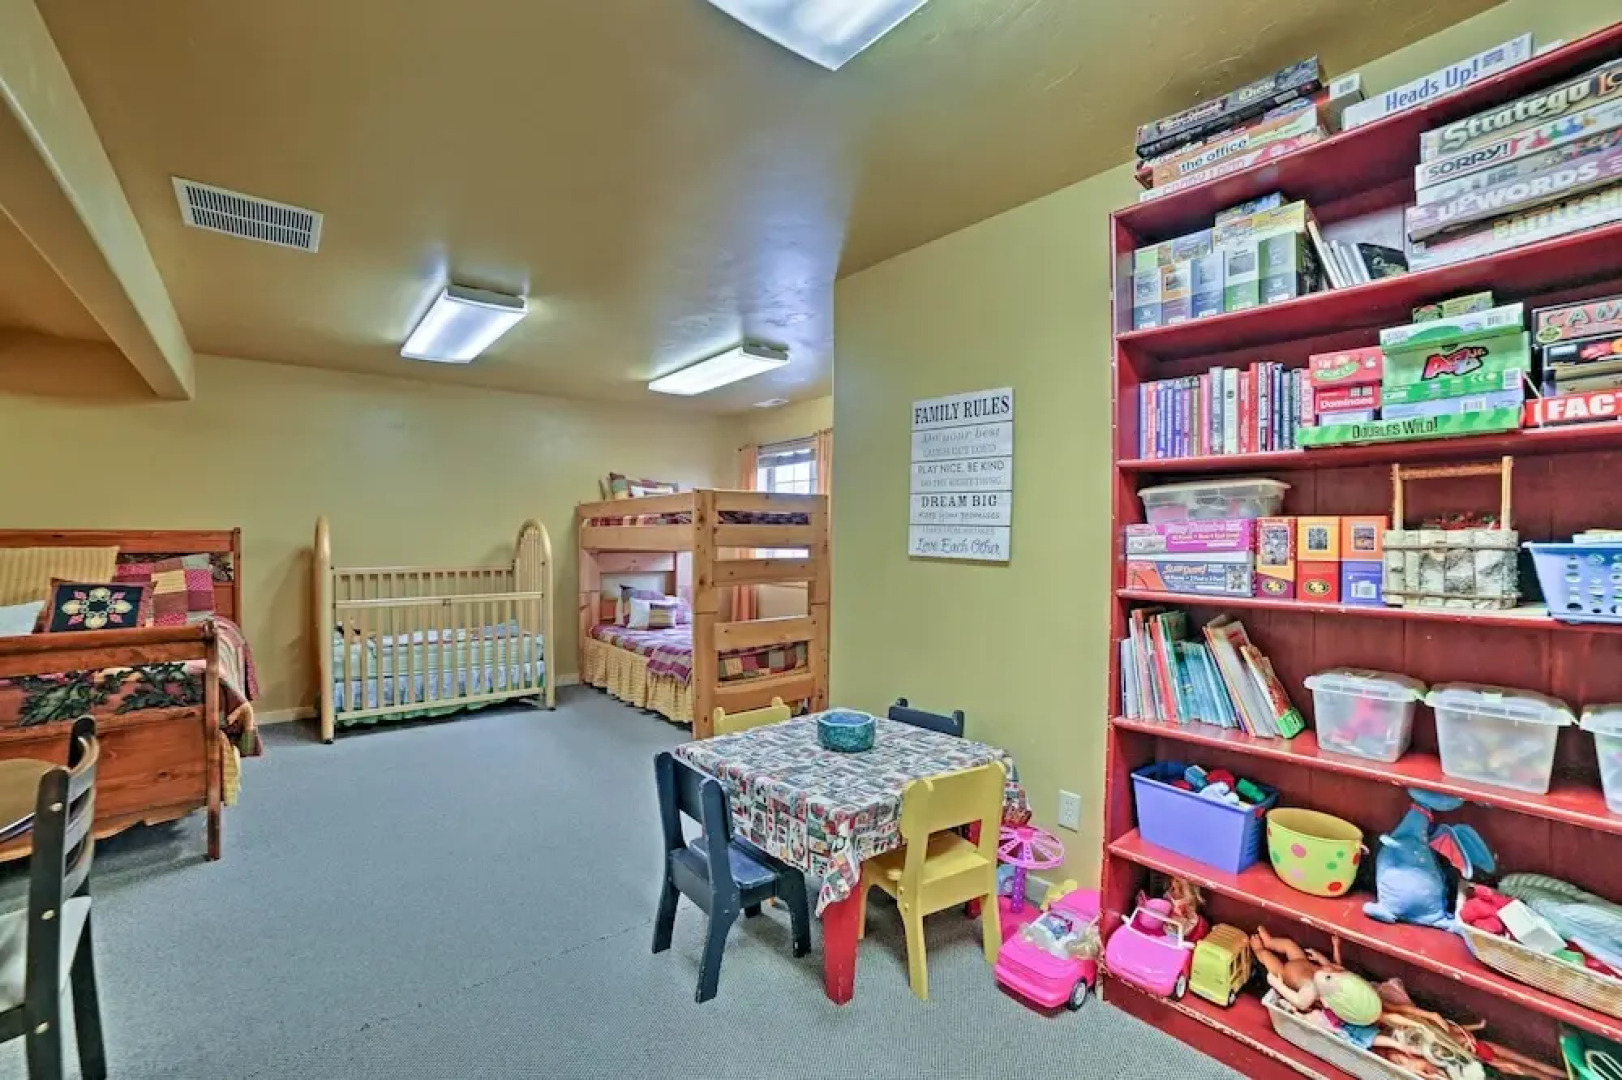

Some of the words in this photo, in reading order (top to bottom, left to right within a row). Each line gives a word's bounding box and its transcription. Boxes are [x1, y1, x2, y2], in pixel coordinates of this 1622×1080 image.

[1385, 78, 1439, 112] Heads
[1445, 58, 1479, 88] Up!
[1438, 78, 1592, 152] Stratego
[1180, 155, 1204, 173] the
[1206, 137, 1248, 163] office
[1427, 142, 1510, 178] SORRY!
[914, 401, 961, 425] FAMILY
[963, 395, 1011, 419] RULES
[1320, 396, 1375, 410] Dominoes
[917, 465, 938, 475] PLAY
[967, 461, 979, 473] BE
[980, 460, 1005, 471] KIND
[920, 495, 968, 508] DREAM
[972, 494, 998, 507] BIG
[940, 537, 969, 554] Each
[970, 538, 1000, 555] Other
